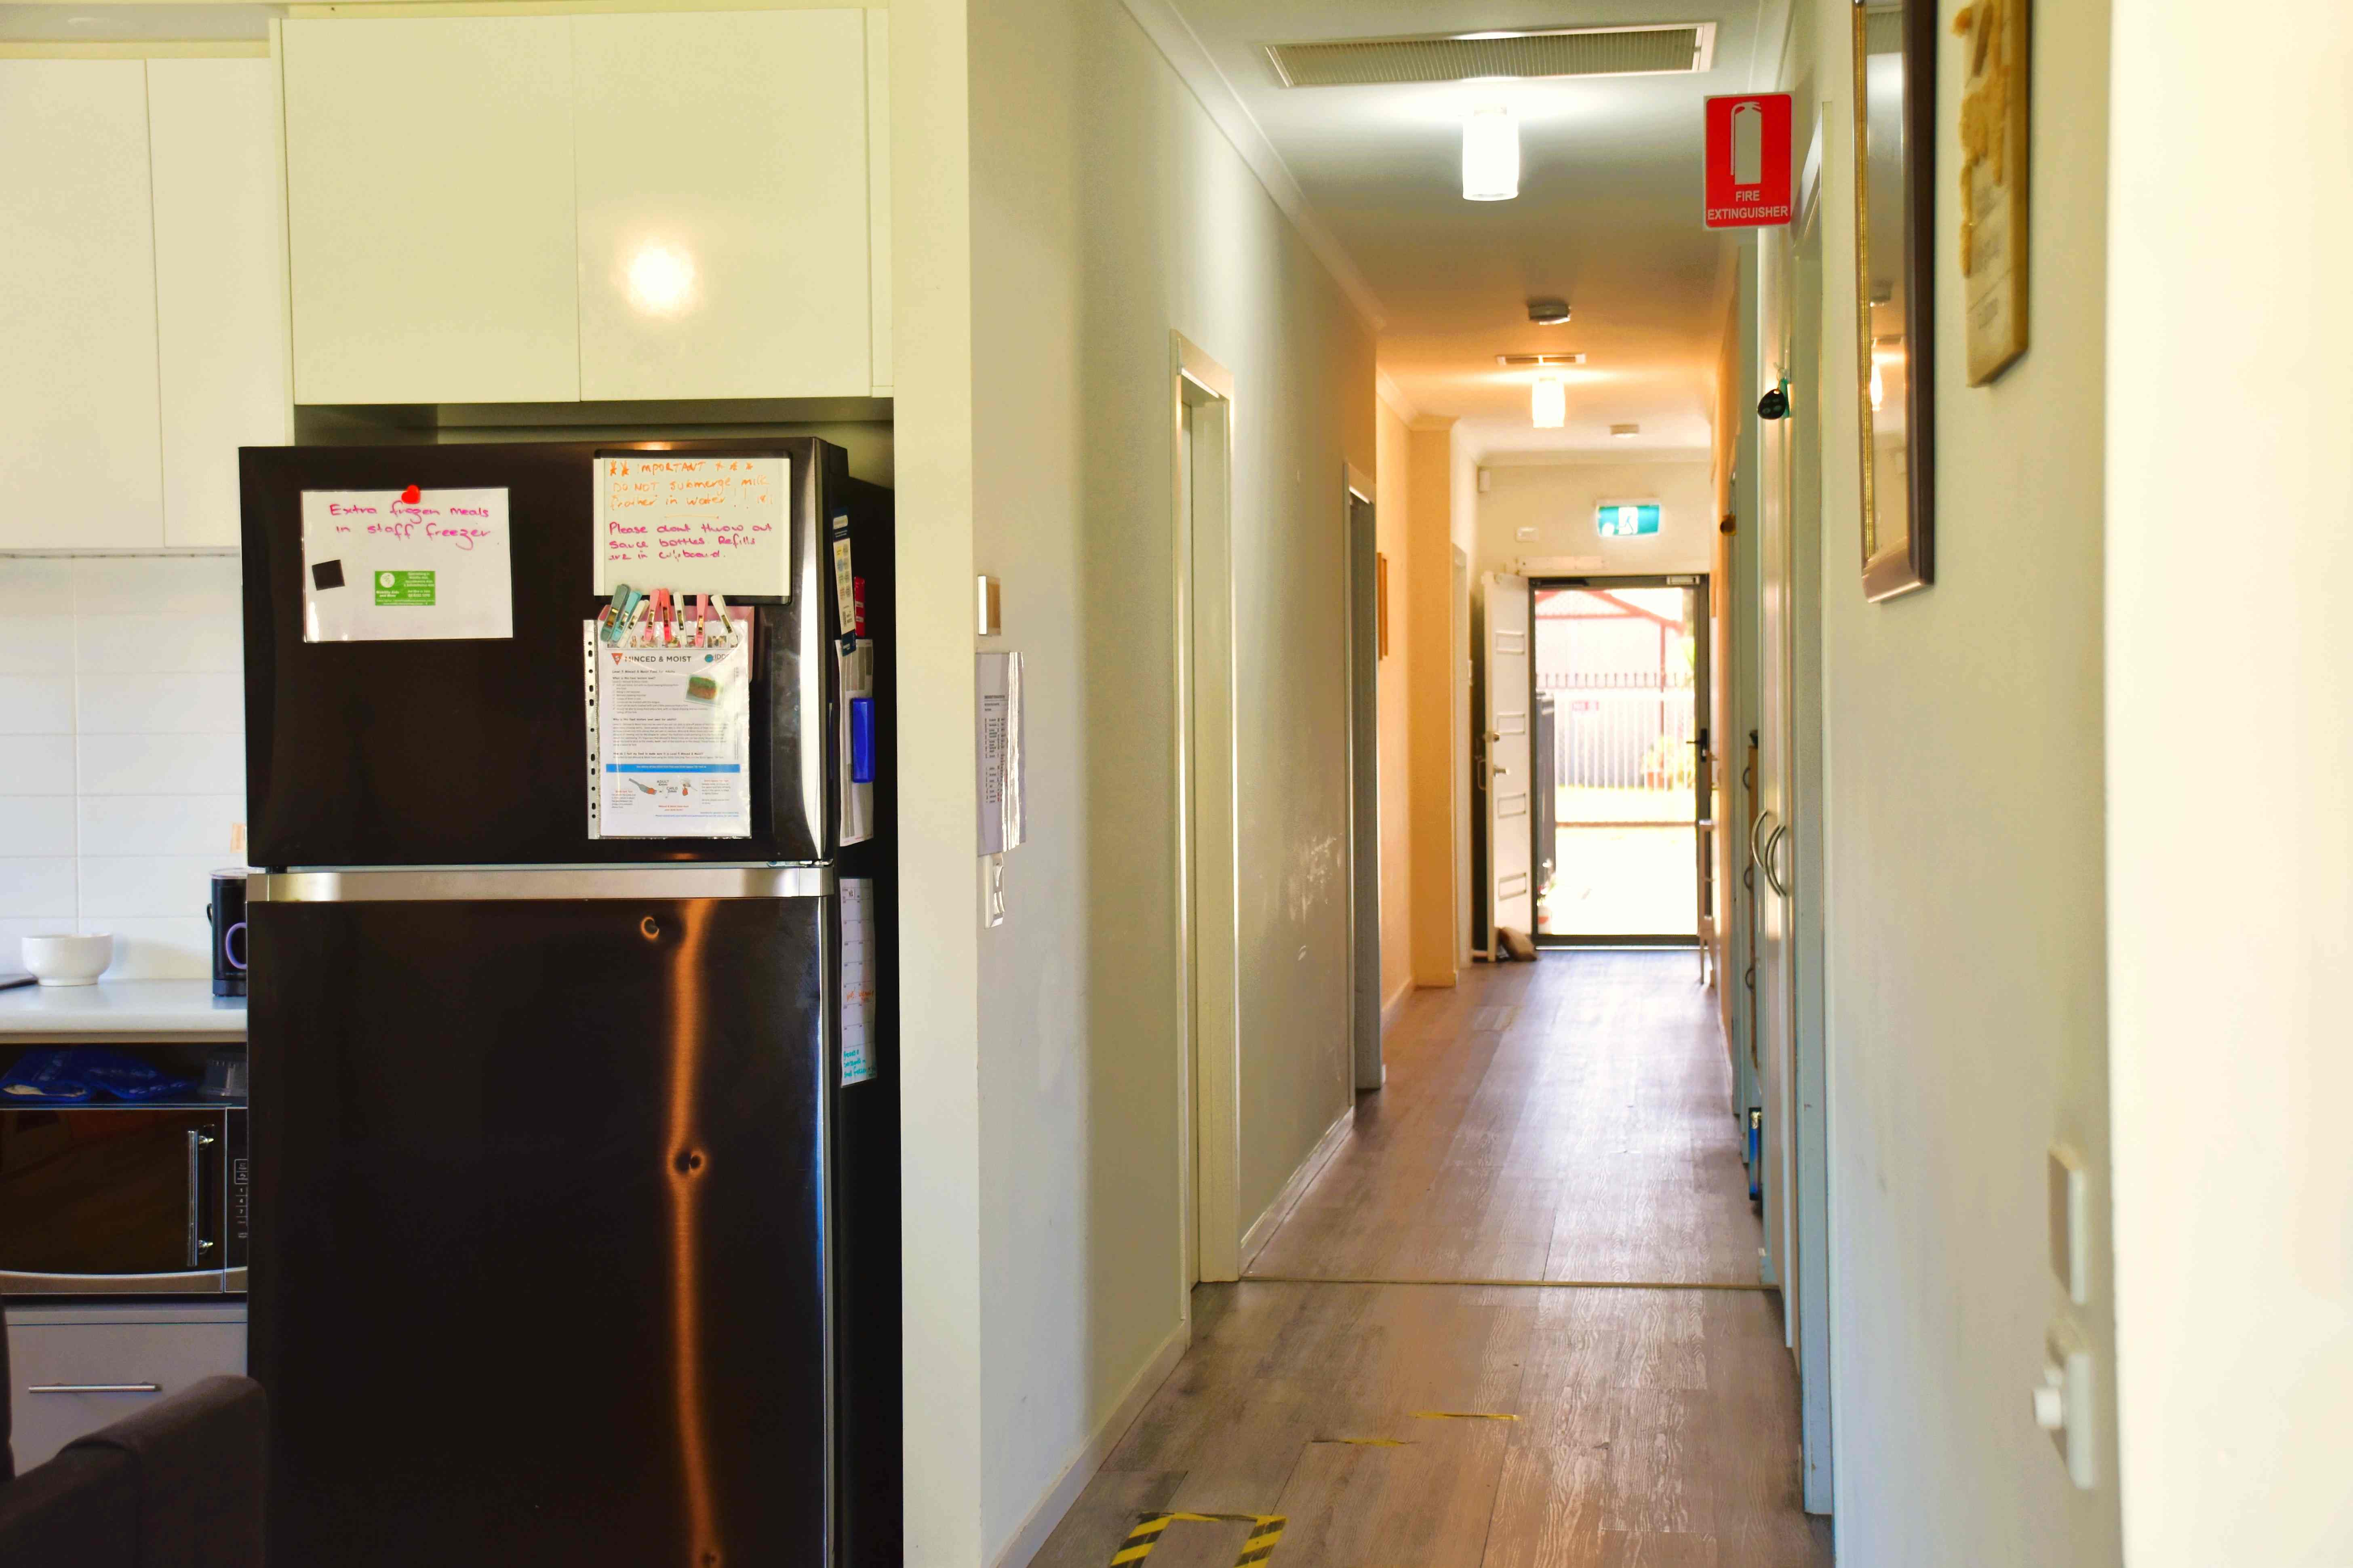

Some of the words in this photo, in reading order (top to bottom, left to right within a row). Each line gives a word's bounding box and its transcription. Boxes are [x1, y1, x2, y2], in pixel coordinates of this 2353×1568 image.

[1736, 190, 1760, 202] FIRE
[1708, 206, 1788, 220] EXTINGUISHER
[634, 481, 659, 492] NOT
[330, 504, 377, 516] Extra
[390, 500, 440, 524] frozen
[609, 521, 648, 535] Please
[701, 523, 744, 533] throw
[752, 523, 772, 531] out
[367, 523, 414, 540] staff
[426, 522, 491, 551] freezer
